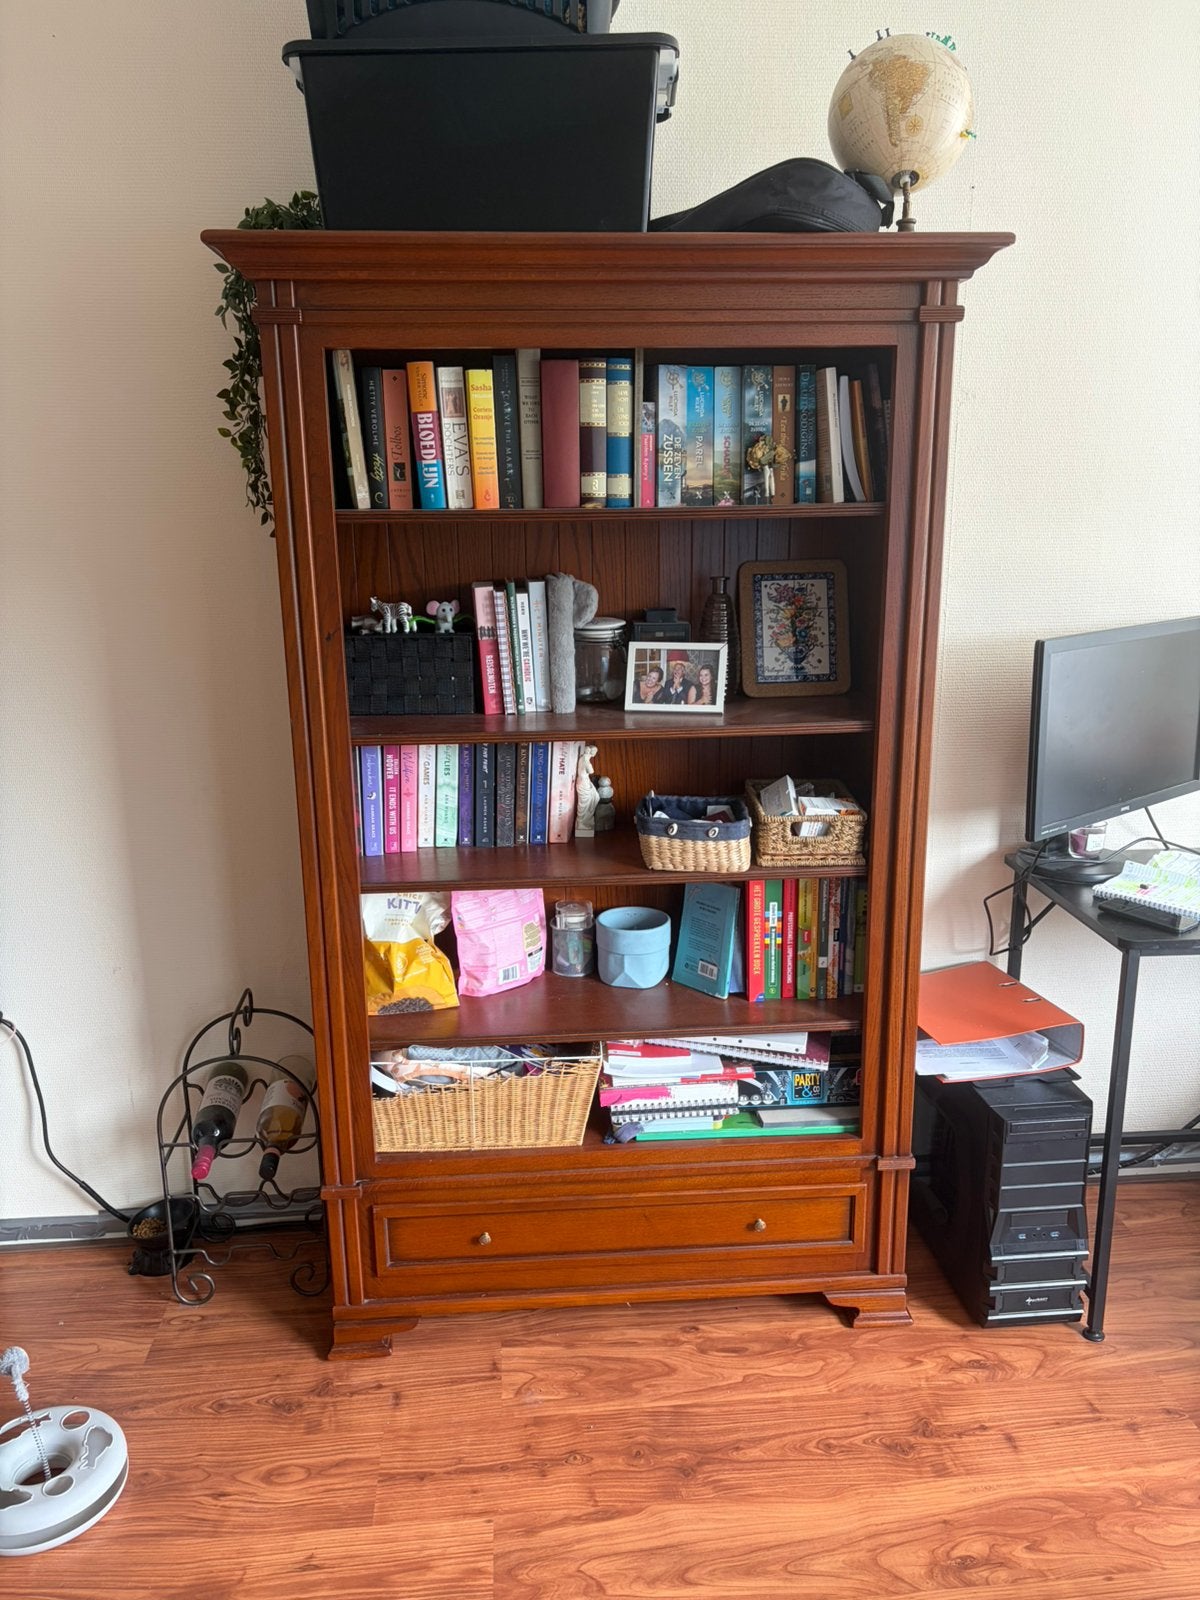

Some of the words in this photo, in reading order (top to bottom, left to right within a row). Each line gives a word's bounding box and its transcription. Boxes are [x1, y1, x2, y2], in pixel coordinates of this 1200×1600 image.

[471, 384, 493, 392] Sasha
[417, 413, 440, 488] BLOEDLIJN
[444, 423, 455, 476] DOCHTERS
[452, 423, 470, 477] EVA'S
[674, 437, 681, 448] DE
[663, 433, 674, 482] ZUSSEN
[674, 452, 682, 479] ZEVEN
[523, 658, 531, 682] CATHOLIC
[389, 827, 396, 835] US
[753, 885, 761, 897] HET
[753, 918, 761, 958] GESPREKKEN
[753, 959, 761, 974] BOEK
[794, 1073, 820, 1086] PARTY
